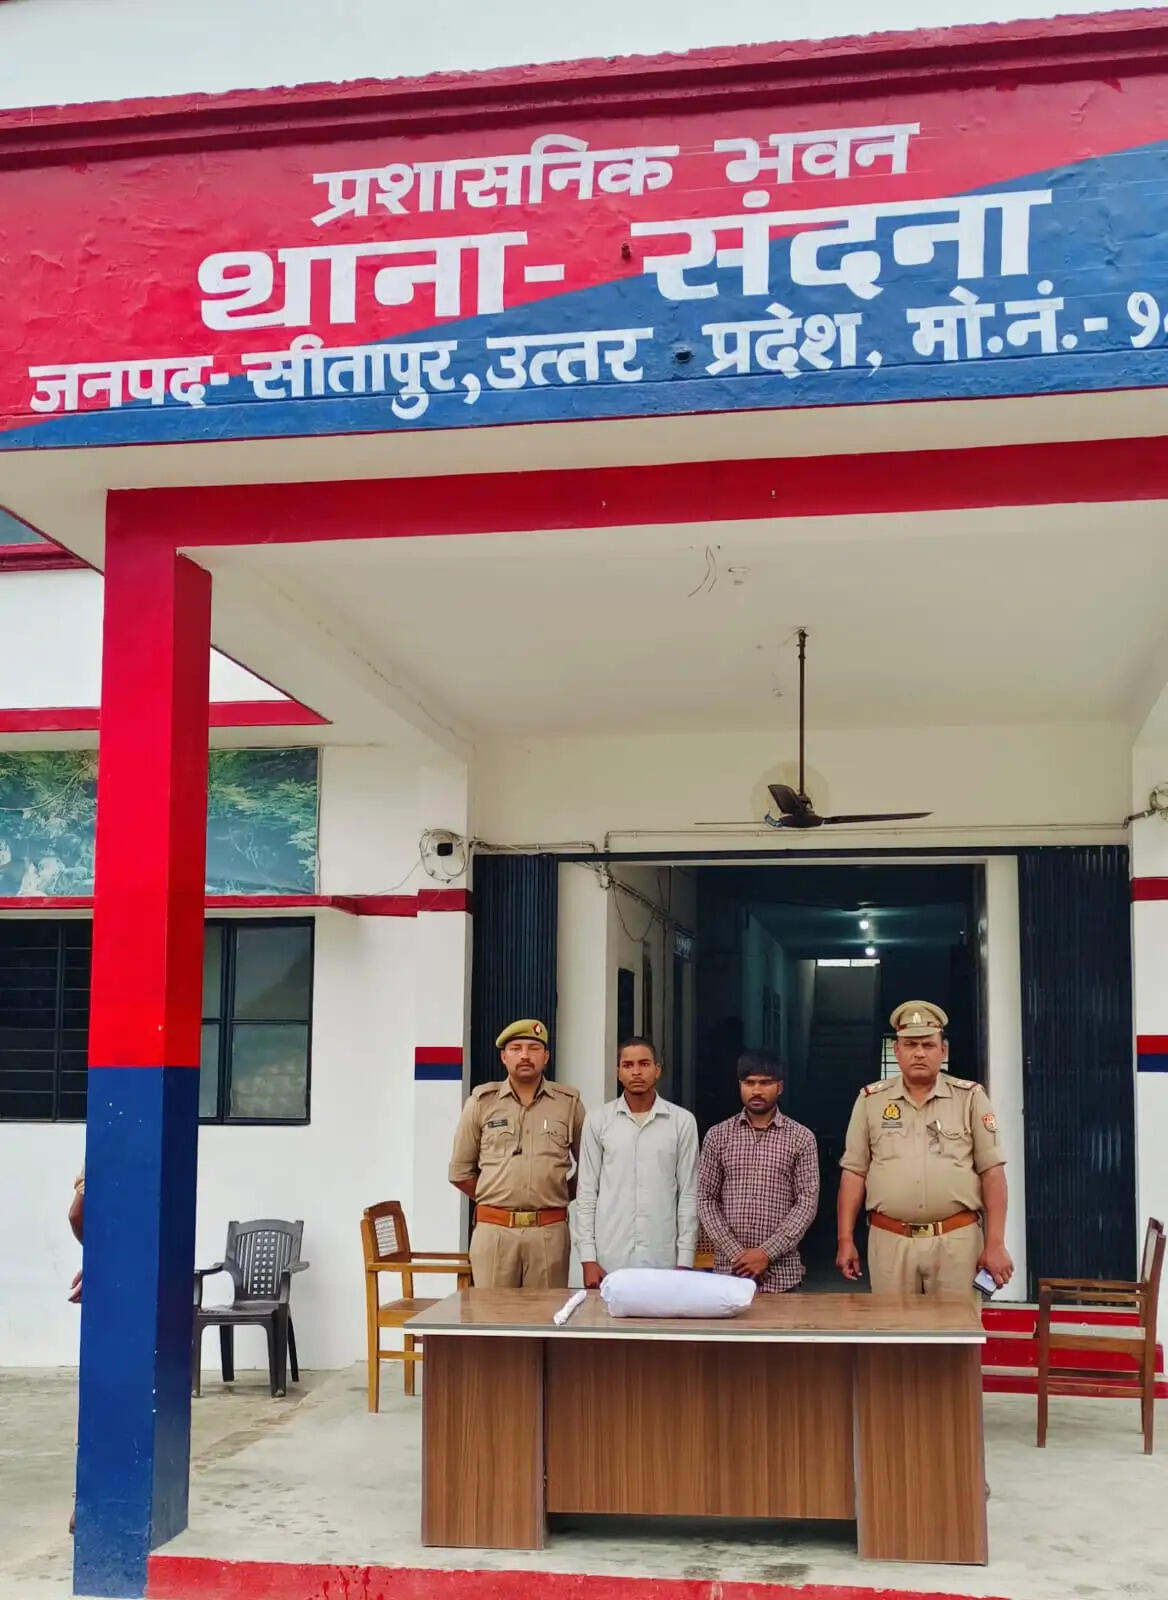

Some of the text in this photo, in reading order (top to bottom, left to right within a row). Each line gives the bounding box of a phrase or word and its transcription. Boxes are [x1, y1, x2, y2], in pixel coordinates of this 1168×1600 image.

[311, 122, 921, 227] प्रशासनिक भवन
[198, 189, 1053, 331] थाना- संदना
[28, 355, 231, 412] जनपद-
